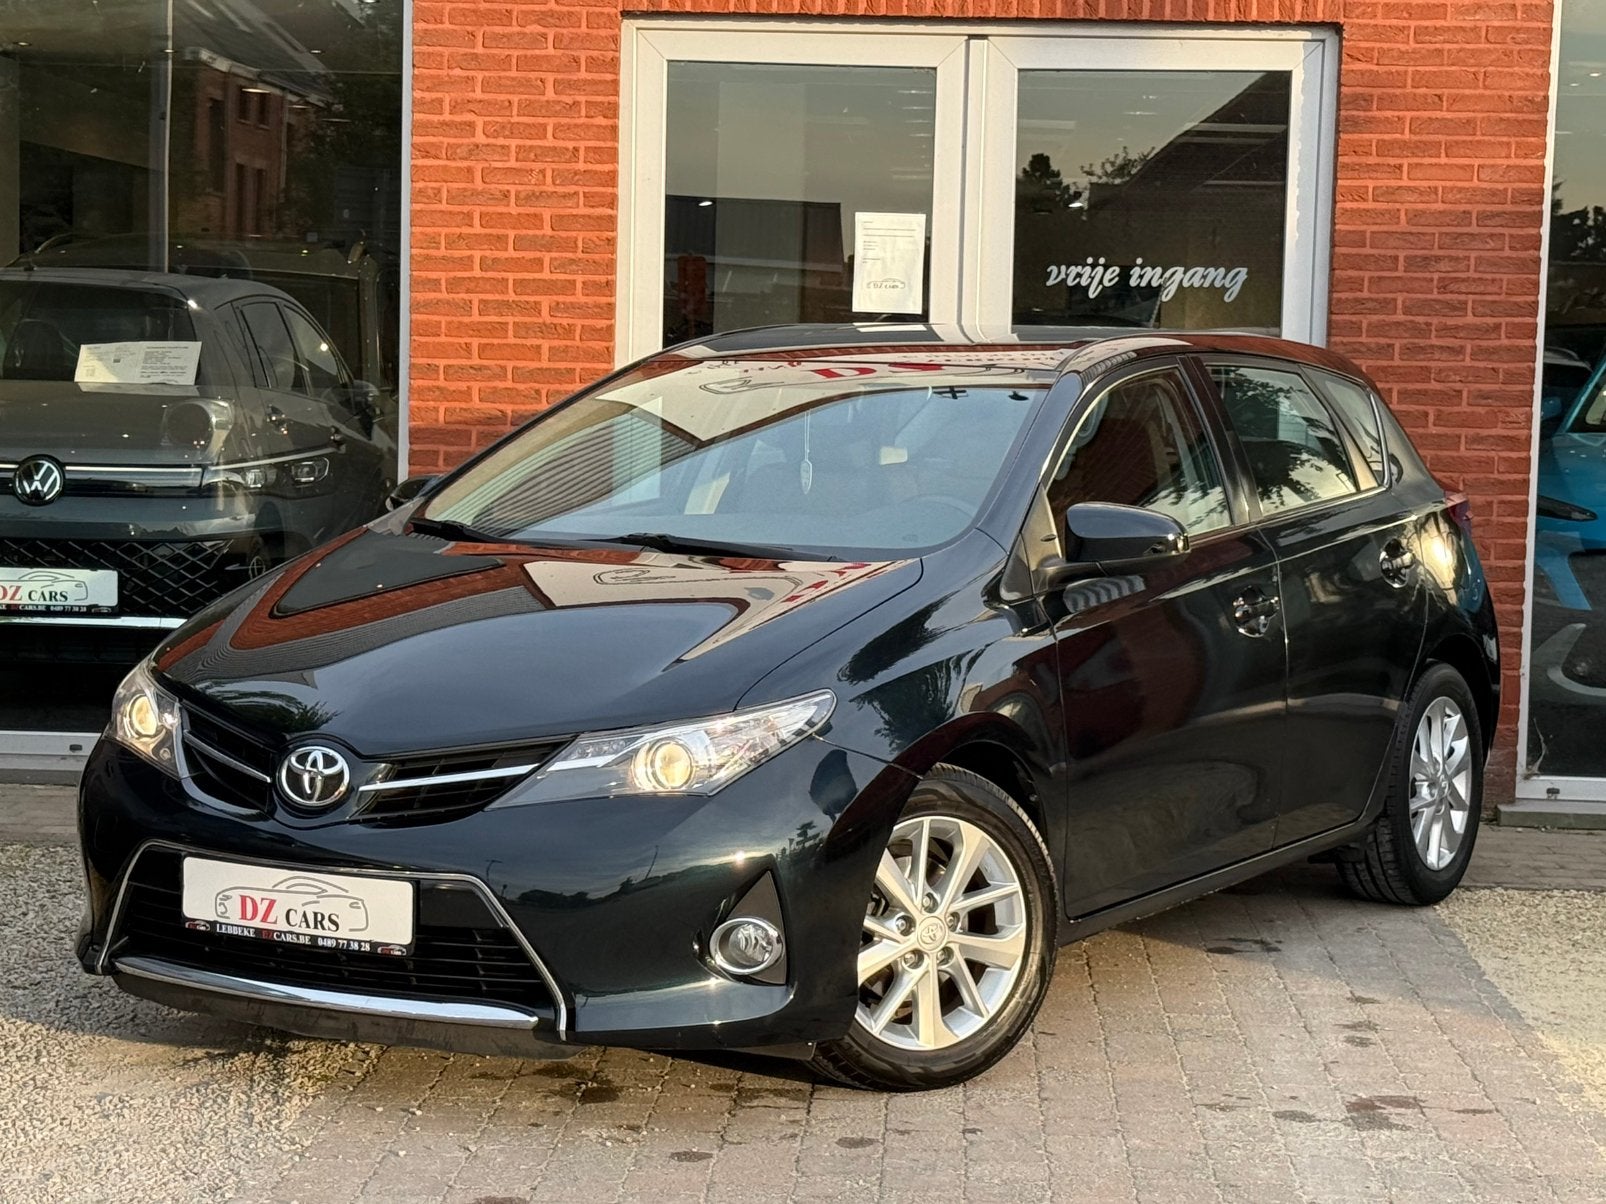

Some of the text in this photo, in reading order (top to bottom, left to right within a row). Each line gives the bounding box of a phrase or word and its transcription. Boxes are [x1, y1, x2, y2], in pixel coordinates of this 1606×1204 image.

[1046, 256, 1248, 303] vrije ingang
[28, 590, 68, 602] CARS
[239, 894, 340, 932] DZ CARS
[216, 923, 256, 937] LEBBEKE
[318, 937, 337, 948] 0489
[338, 940, 347, 949] 77
[360, 942, 371, 952] 28
